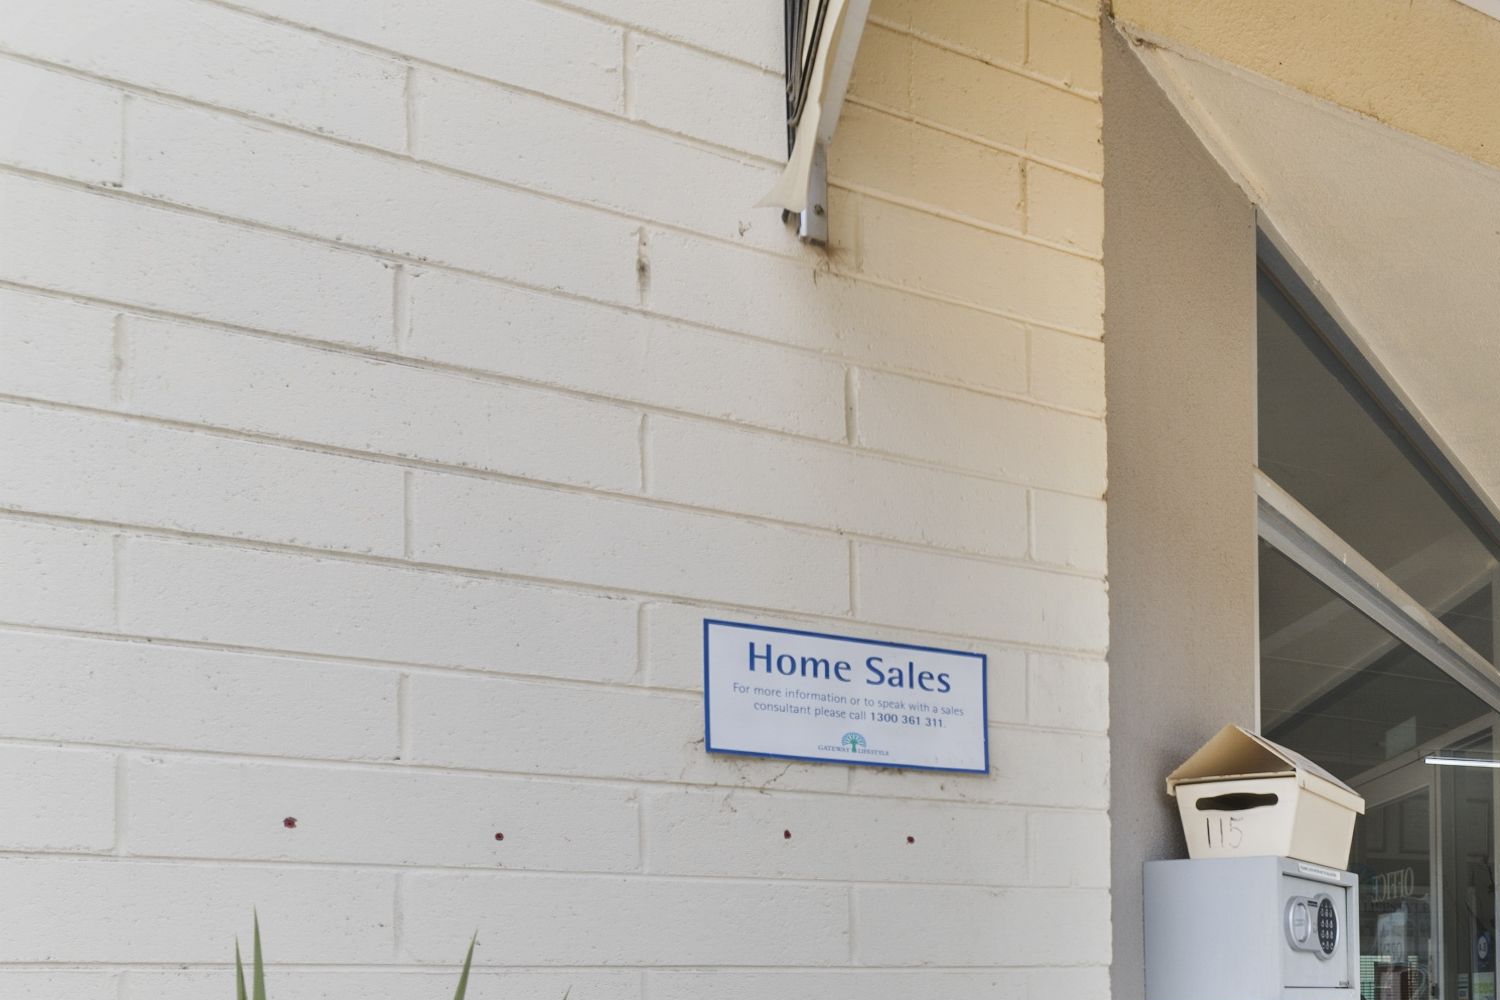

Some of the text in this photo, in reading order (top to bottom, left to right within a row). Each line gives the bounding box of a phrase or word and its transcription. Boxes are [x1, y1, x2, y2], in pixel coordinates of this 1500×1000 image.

[748, 641, 952, 693] Home Sales
[733, 682, 965, 717] For more information or to speak with a sales
[753, 701, 811, 716] consultant
[814, 706, 847, 720] please
[849, 710, 867, 721] call
[871, 711, 899, 723] 1300
[901, 714, 921, 726] 361
[817, 744, 890, 757] GATEWAY LIFESTYLE
[1206, 816, 1244, 849] 115
